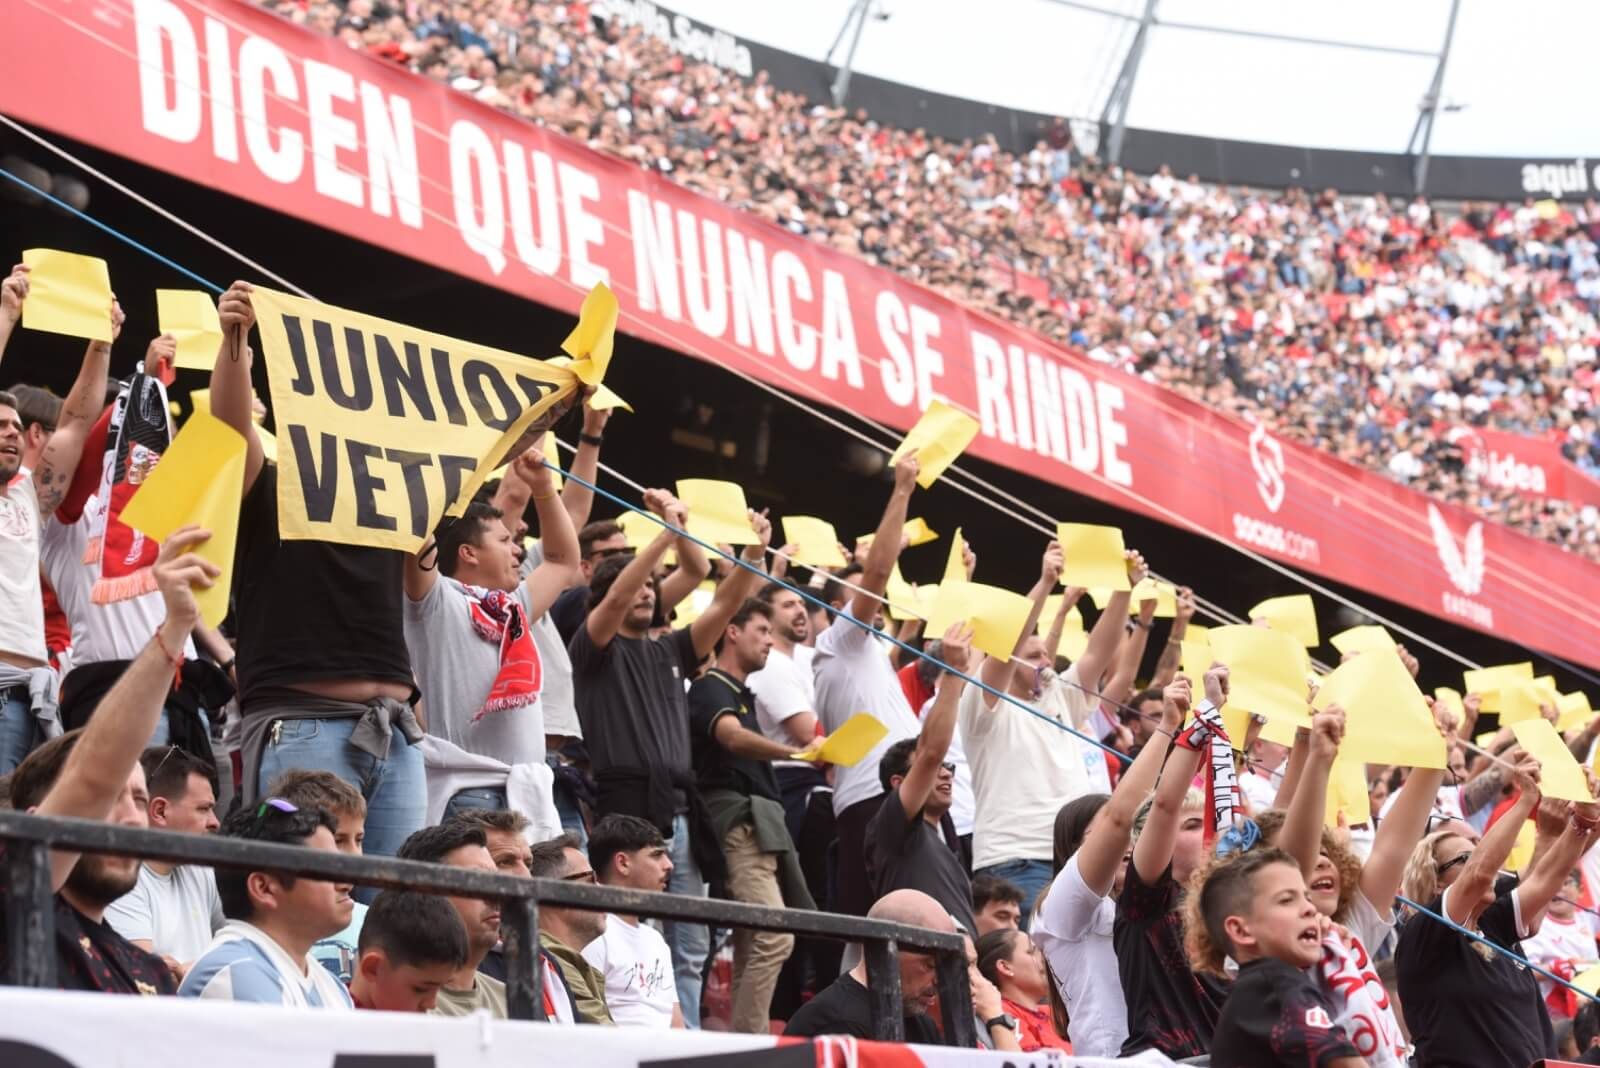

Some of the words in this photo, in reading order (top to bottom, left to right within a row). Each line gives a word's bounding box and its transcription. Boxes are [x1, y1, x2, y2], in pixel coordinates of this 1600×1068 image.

[134, 0, 423, 229] DICEN
[449, 119, 610, 291] QUE
[626, 188, 865, 390] NUNCA
[876, 289, 949, 411] SE
[970, 330, 1133, 485] RINDE
